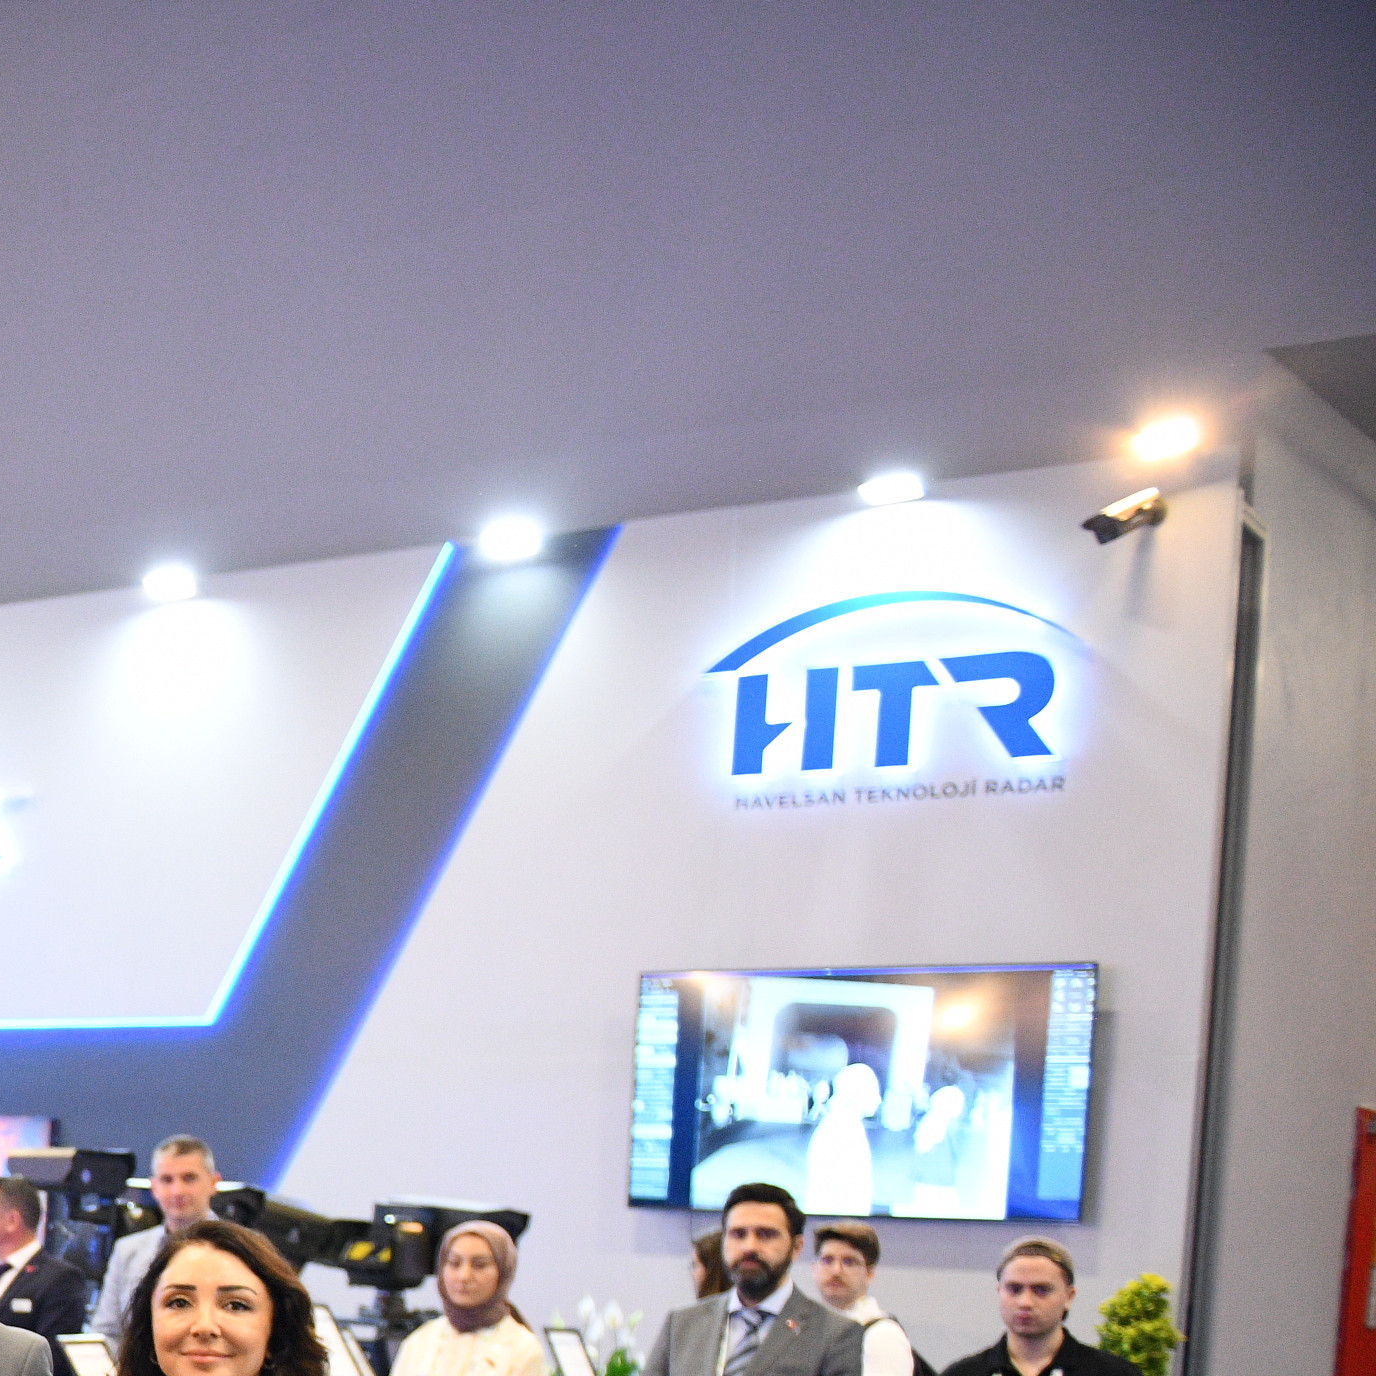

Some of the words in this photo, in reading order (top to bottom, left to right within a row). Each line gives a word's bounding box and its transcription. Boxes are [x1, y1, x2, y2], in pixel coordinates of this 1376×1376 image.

[731, 651, 1055, 776] HTR
[735, 788, 846, 811] HAVELSAN
[855, 779, 977, 804] TEKNOLOJİ
[985, 775, 1065, 795] RADAR
